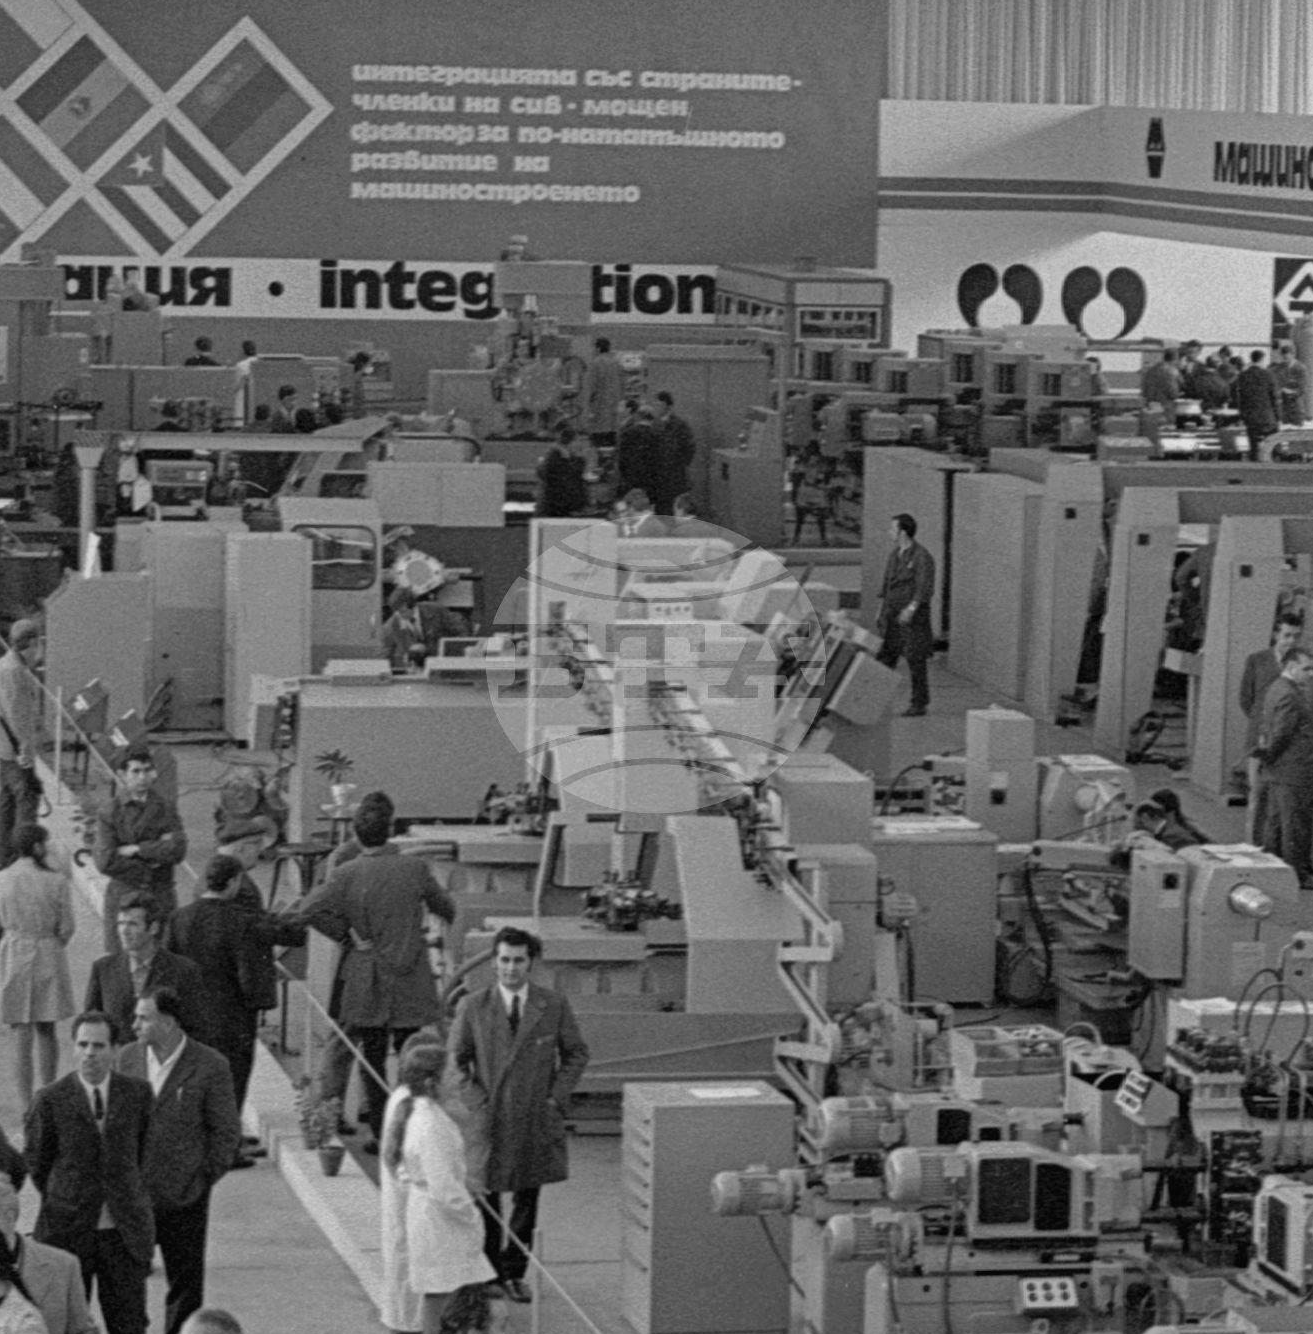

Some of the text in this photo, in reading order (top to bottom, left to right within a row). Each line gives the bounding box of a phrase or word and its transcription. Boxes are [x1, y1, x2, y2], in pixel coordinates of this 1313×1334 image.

[351, 64, 577, 87] интеграцията
[584, 70, 632, 87] със
[352, 92, 455, 112] членки
[462, 96, 500, 113] на
[582, 99, 689, 118] мощен
[351, 150, 550, 172] развитие на
[350, 182, 640, 204] машиностроенето
[320, 260, 717, 321] integtion
